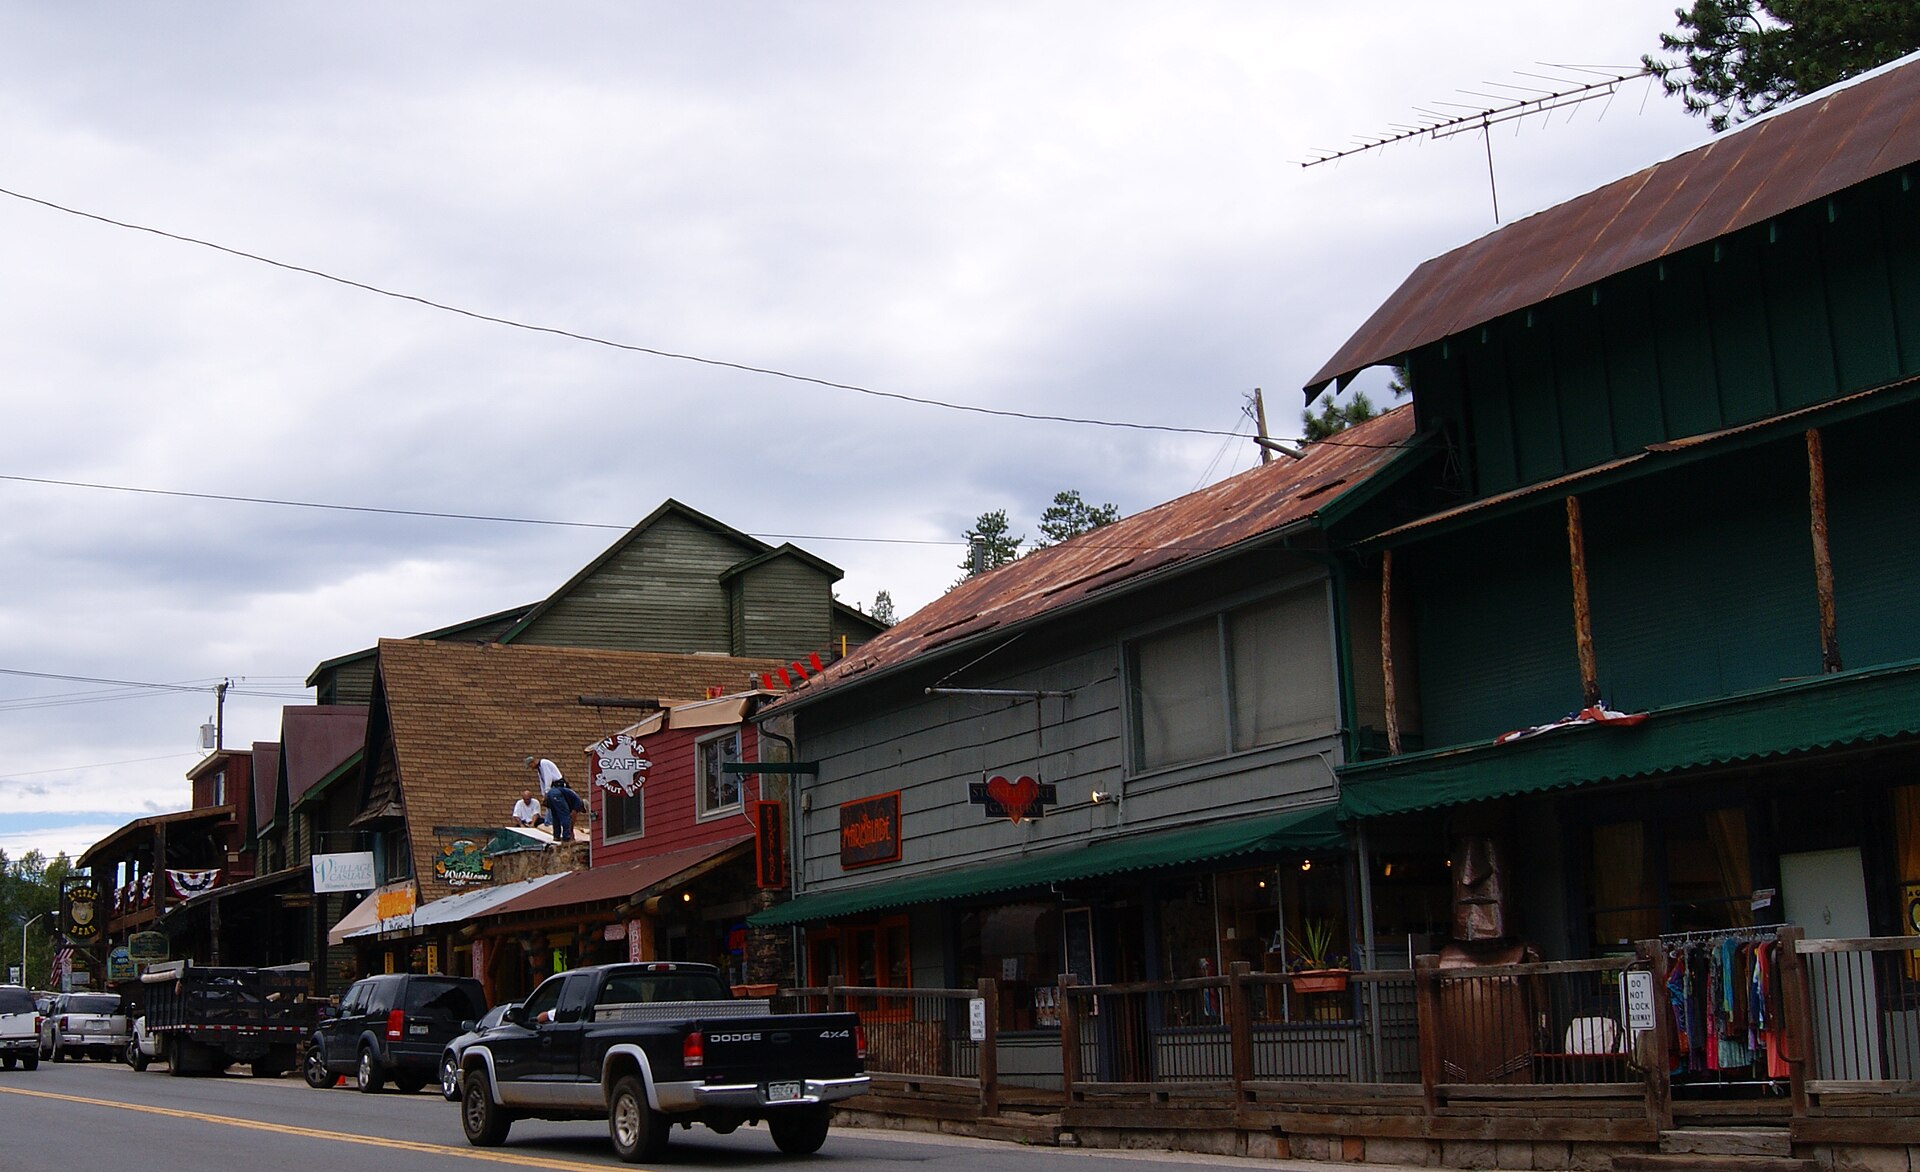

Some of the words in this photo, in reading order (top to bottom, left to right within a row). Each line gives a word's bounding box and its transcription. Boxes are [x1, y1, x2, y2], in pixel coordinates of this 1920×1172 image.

[597, 736, 614, 755] TIN
[616, 735, 646, 755] STAR
[598, 758, 648, 771] CAFE
[596, 773, 622, 794] DONUT
[334, 863, 372, 873] VILLAGE
[329, 871, 373, 882] CASUALS
[68, 889, 98, 902] LITTLE
[71, 925, 96, 936] BEAR
[1631, 980, 1641, 988] DO
[1629, 991, 1645, 999] NOT
[1629, 1002, 1650, 1011] LOCK
[710, 1033, 762, 1043] DODGE
